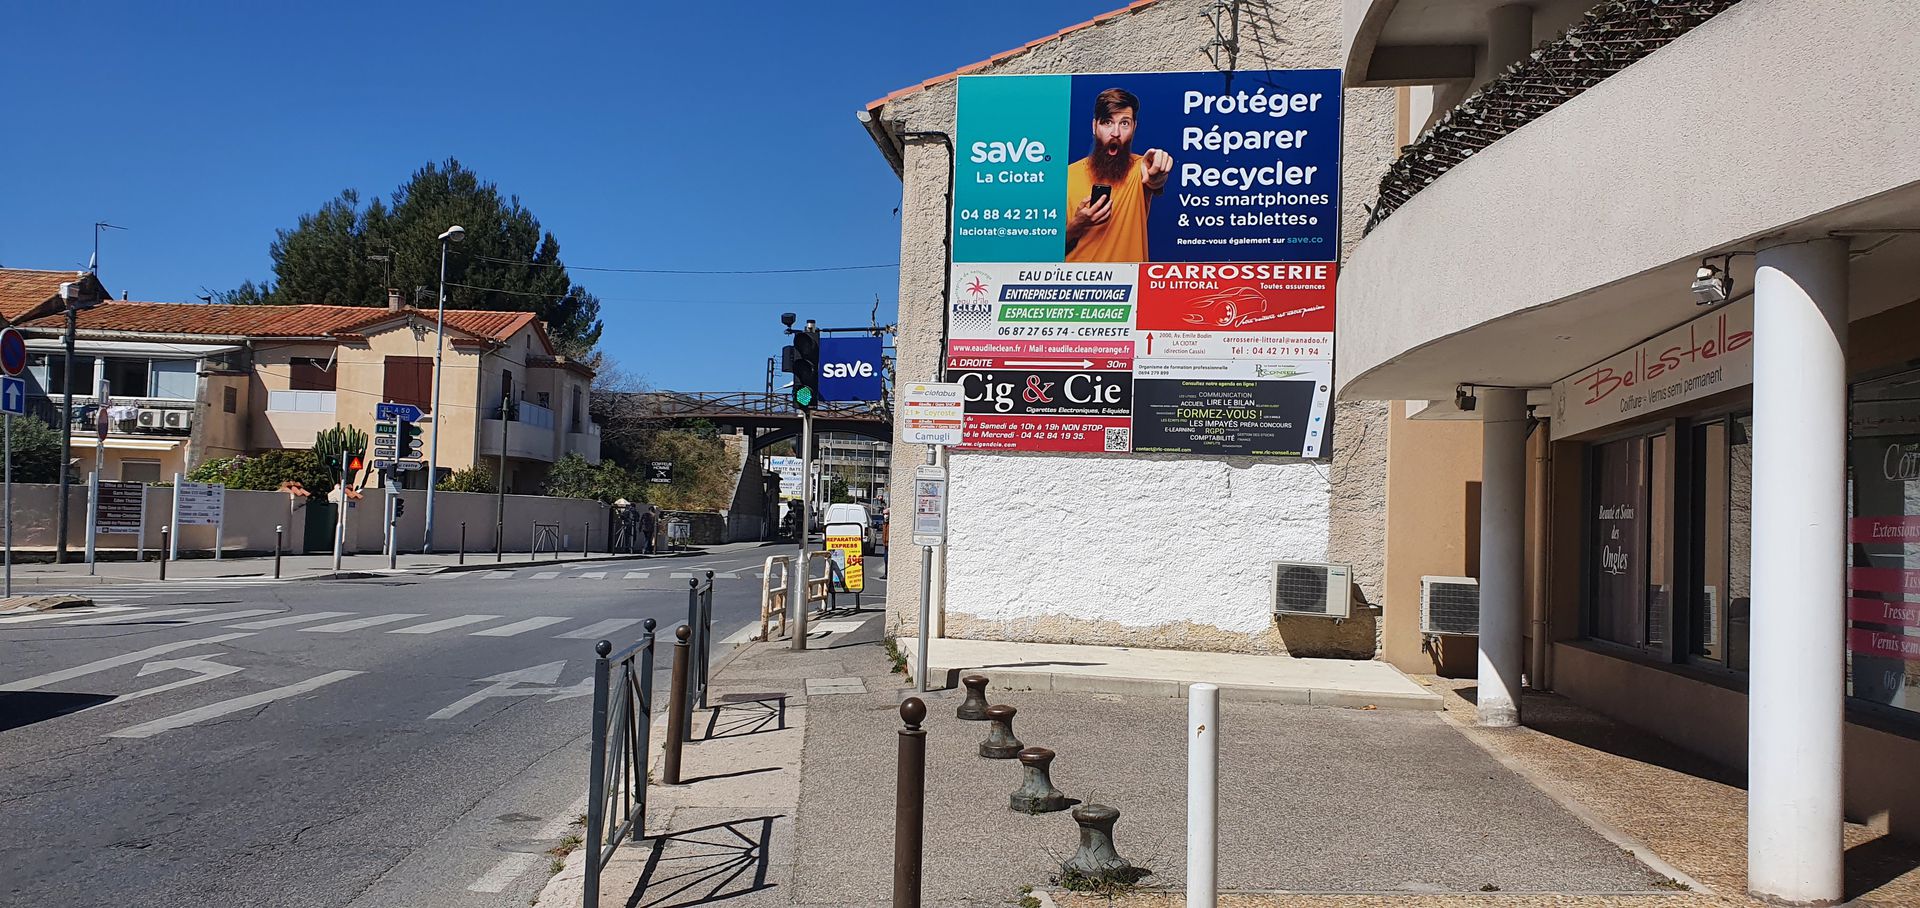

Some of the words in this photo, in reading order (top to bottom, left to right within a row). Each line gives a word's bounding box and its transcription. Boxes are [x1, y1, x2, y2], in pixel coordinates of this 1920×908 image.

[1184, 88, 1322, 118] Protéger
[1183, 124, 1307, 156] Réparer
[976, 171, 994, 184] La
[998, 170, 1044, 184] Ciotat
[1181, 161, 1317, 192] Recycler
[1179, 194, 1210, 208] Vos
[1215, 192, 1329, 211] smartphones
[961, 209, 979, 221] 04
[983, 209, 1000, 221] 88
[1004, 209, 1021, 221] 42
[1024, 209, 1039, 221] 21
[1042, 208, 1057, 220] 14
[1178, 213, 1189, 227] &
[1195, 215, 1225, 227] vos
[959, 226, 1058, 238] laciotat@save.store
[1177, 238, 1228, 246] Rendez-vous
[1229, 236, 1270, 246] également
[1287, 236, 1323, 244] save.co
[1019, 271, 1040, 281] EAU
[1075, 271, 1113, 281] CLEAN
[1147, 265, 1327, 280] CARROSSERIE
[1150, 281, 1166, 290] DU
[1170, 280, 1219, 290] LITTORAL
[1260, 282, 1283, 290] Toutes
[1005, 289, 1058, 300] ENTREPRISE
[1058, 289, 1071, 300] DE
[1072, 289, 1126, 300] NETTOYAGE
[1005, 308, 1044, 319] ESPACES
[1046, 308, 1073, 319] VERTS
[1080, 308, 1125, 319] ELAGAGE
[998, 326, 1010, 336] 06
[1012, 327, 1025, 336] 87
[1027, 327, 1039, 336] 27
[1041, 327, 1053, 336] 65
[1056, 327, 1069, 336] 74
[1077, 327, 1130, 337] CEYRESTE
[1223, 336, 1328, 345] carrosserie-littoral@wanadoo.fr
[1252, 347, 1263, 355] 04
[1266, 347, 1277, 355] 42
[1280, 347, 1289, 355] 71
[950, 359, 957, 367] A
[960, 359, 993, 367] DROITE
[1106, 360, 1127, 368] 30m
[957, 372, 1015, 413] Cig
[1022, 374, 1054, 403] &
[1063, 373, 1121, 403] Cie
[1620, 398, 1642, 413] Coiffure
[1648, 386, 1667, 405] Vernis
[1667, 379, 1683, 397] semi
[1684, 365, 1722, 396] permanent
[1199, 391, 1253, 399] COMMUNICATION
[1026, 406, 1056, 414] Cigarettes
[1177, 409, 1257, 420] FORMEZ-VOUS
[980, 422, 1007, 430] Samedi
[1205, 419, 1238, 428] IMPAYÉS
[915, 432, 950, 442] Camugli
[981, 431, 1015, 439] Mercredi
[1883, 443, 1920, 480] Coi
[1872, 521, 1920, 538] Extensions
[1603, 545, 1628, 575] Ongles
[1883, 602, 1915, 621] Tresses
[1872, 632, 1899, 652] Vernis
